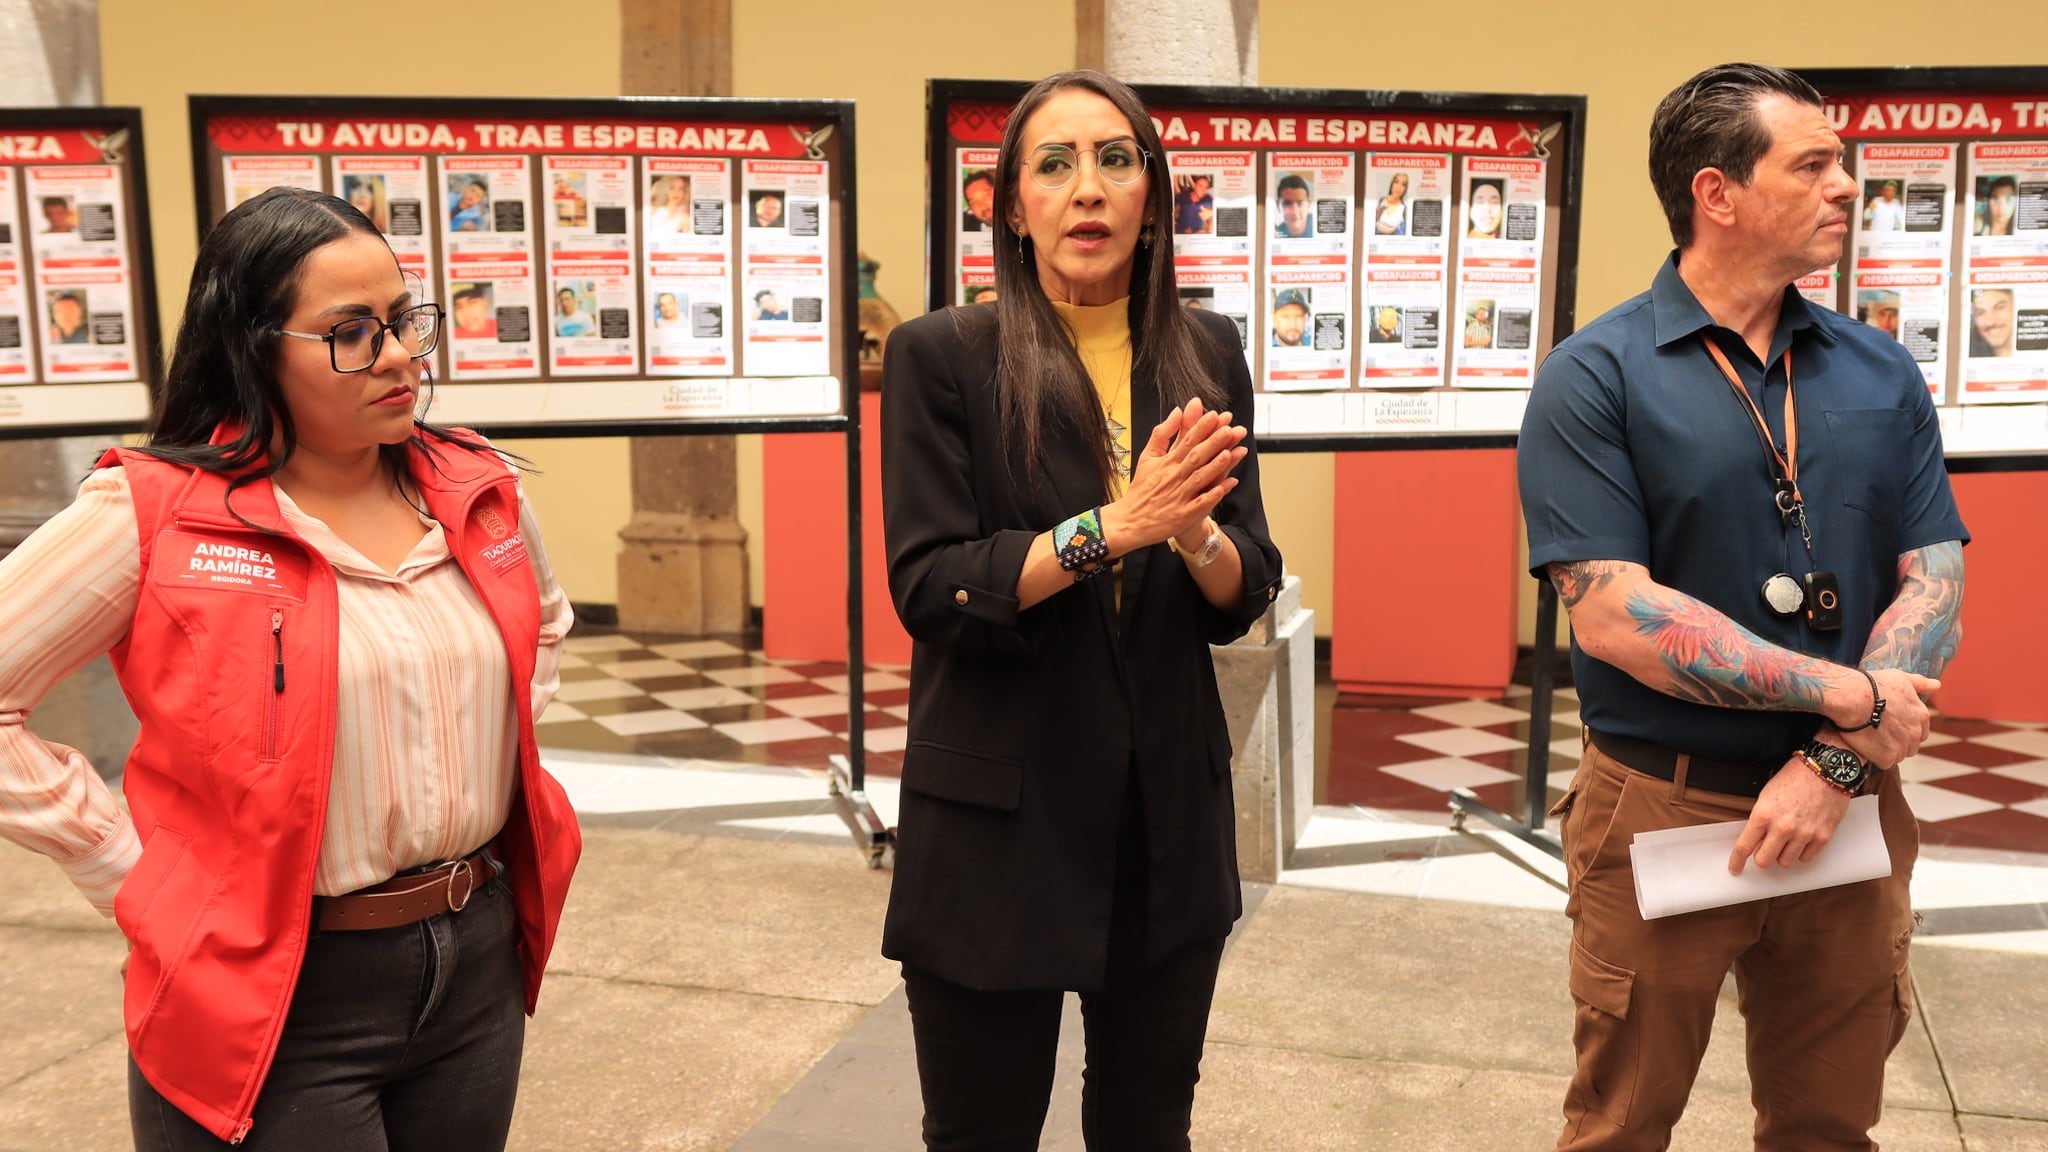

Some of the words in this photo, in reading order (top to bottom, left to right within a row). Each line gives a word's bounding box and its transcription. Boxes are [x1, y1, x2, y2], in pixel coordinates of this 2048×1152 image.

[1858, 102, 2002, 133] AYUDA,
[276, 122, 324, 147] TU
[332, 123, 467, 151] AYUDA,
[474, 124, 565, 148] TRAE
[573, 125, 771, 151] ESPERANZA
[1209, 117, 1297, 142] TRAE
[1306, 118, 1498, 150] ESPERANZA
[1871, 147, 1945, 157] DESAPARECIDO
[1982, 146, 2048, 156] DESAPARECID
[1177, 157, 1245, 165] DESAPARECIDO
[1278, 157, 1344, 166] DESAPARECIDO
[1377, 158, 1441, 168] DESAPARECIDA
[1473, 162, 1537, 172] DESAPARECIDO
[1177, 273, 1244, 283] DESAPARECIDO
[1276, 272, 1342, 281] DESAPARECIDO
[1373, 271, 1437, 280] DESAPARECIDO
[1468, 273, 1530, 281] DESAPARECIDO
[1863, 274, 1937, 284] DESAPARECIDO
[1381, 398, 1415, 408] Ciudad
[1416, 398, 1429, 407] de
[1374, 407, 1385, 416] La
[1387, 407, 1433, 418] Esperanza
[194, 543, 274, 566] ANDREA
[189, 557, 276, 580] RAMÍREZ
[211, 575, 253, 586] REGIDORA
